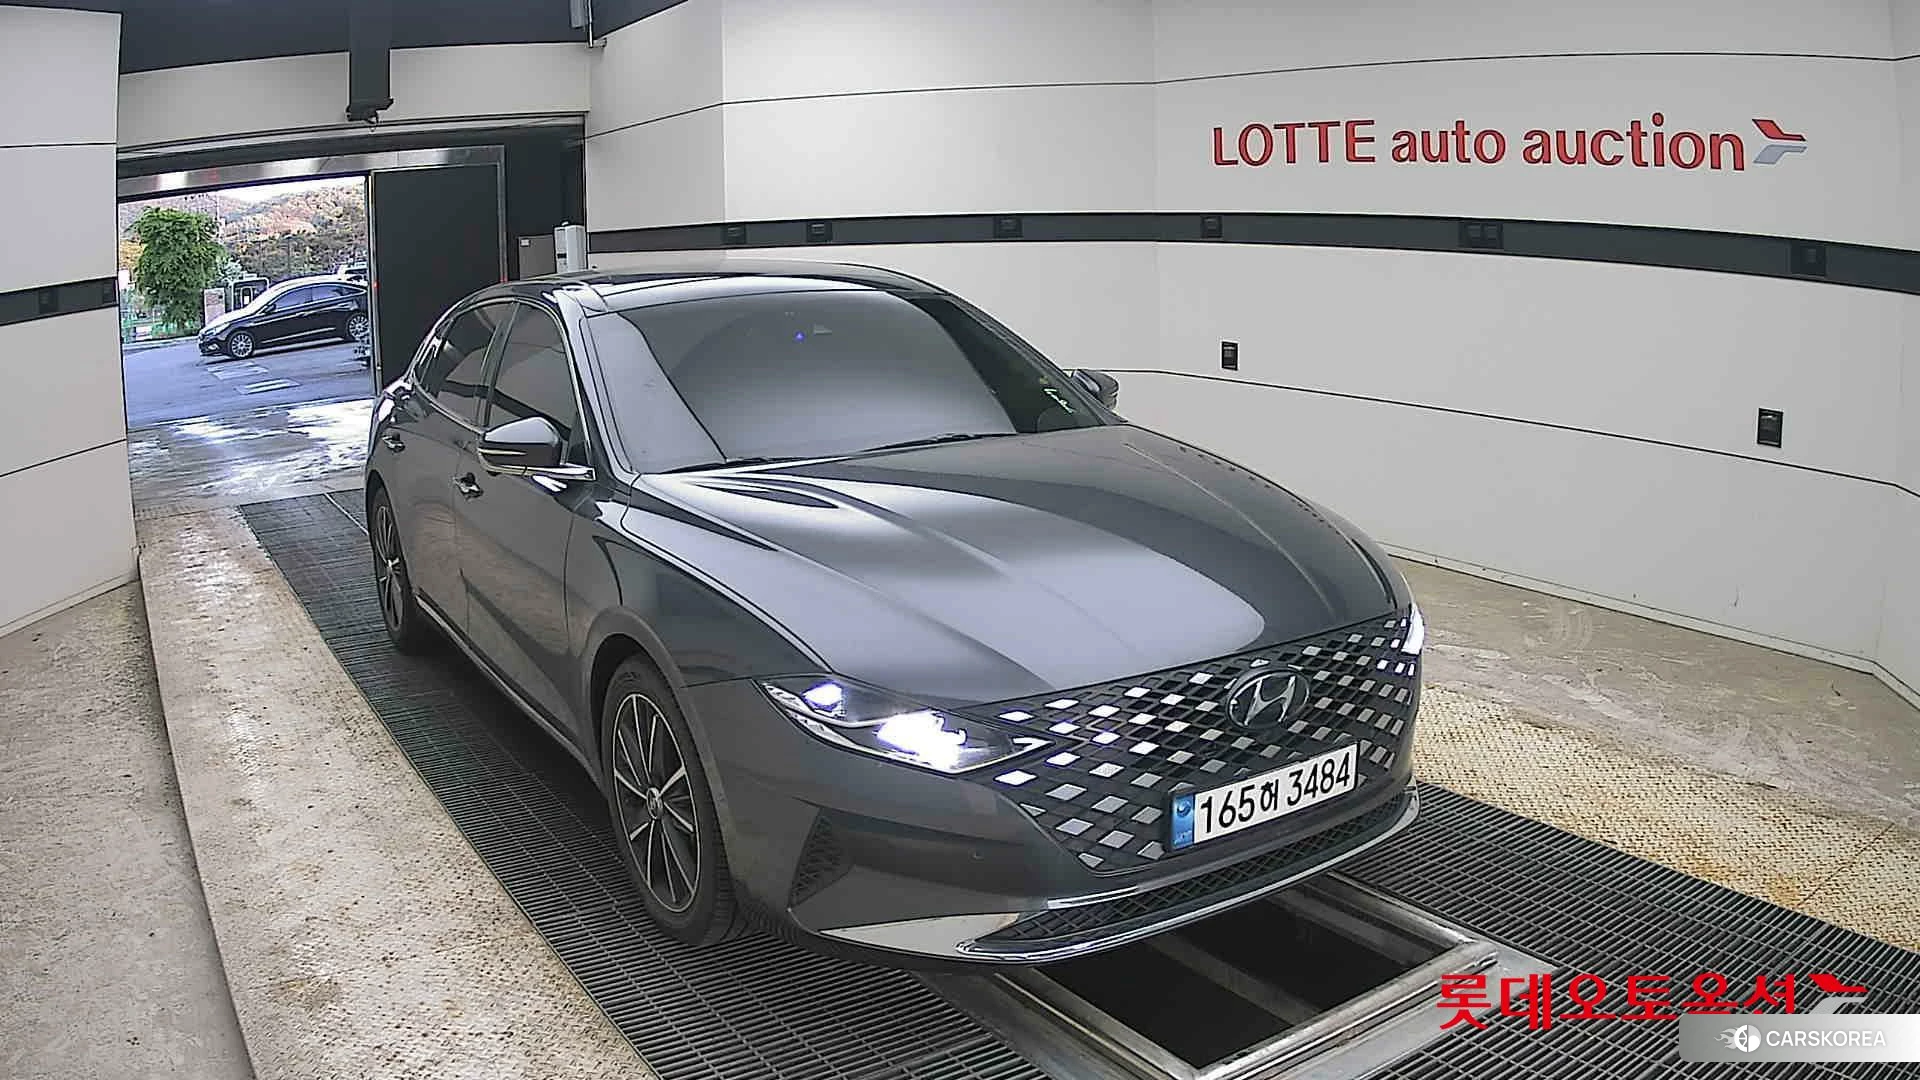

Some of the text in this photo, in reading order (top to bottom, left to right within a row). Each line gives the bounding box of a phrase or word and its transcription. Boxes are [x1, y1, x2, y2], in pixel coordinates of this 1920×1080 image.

[1213, 112, 1746, 171] LOTTE auto auction
[1200, 751, 1351, 834] 165허 3484
